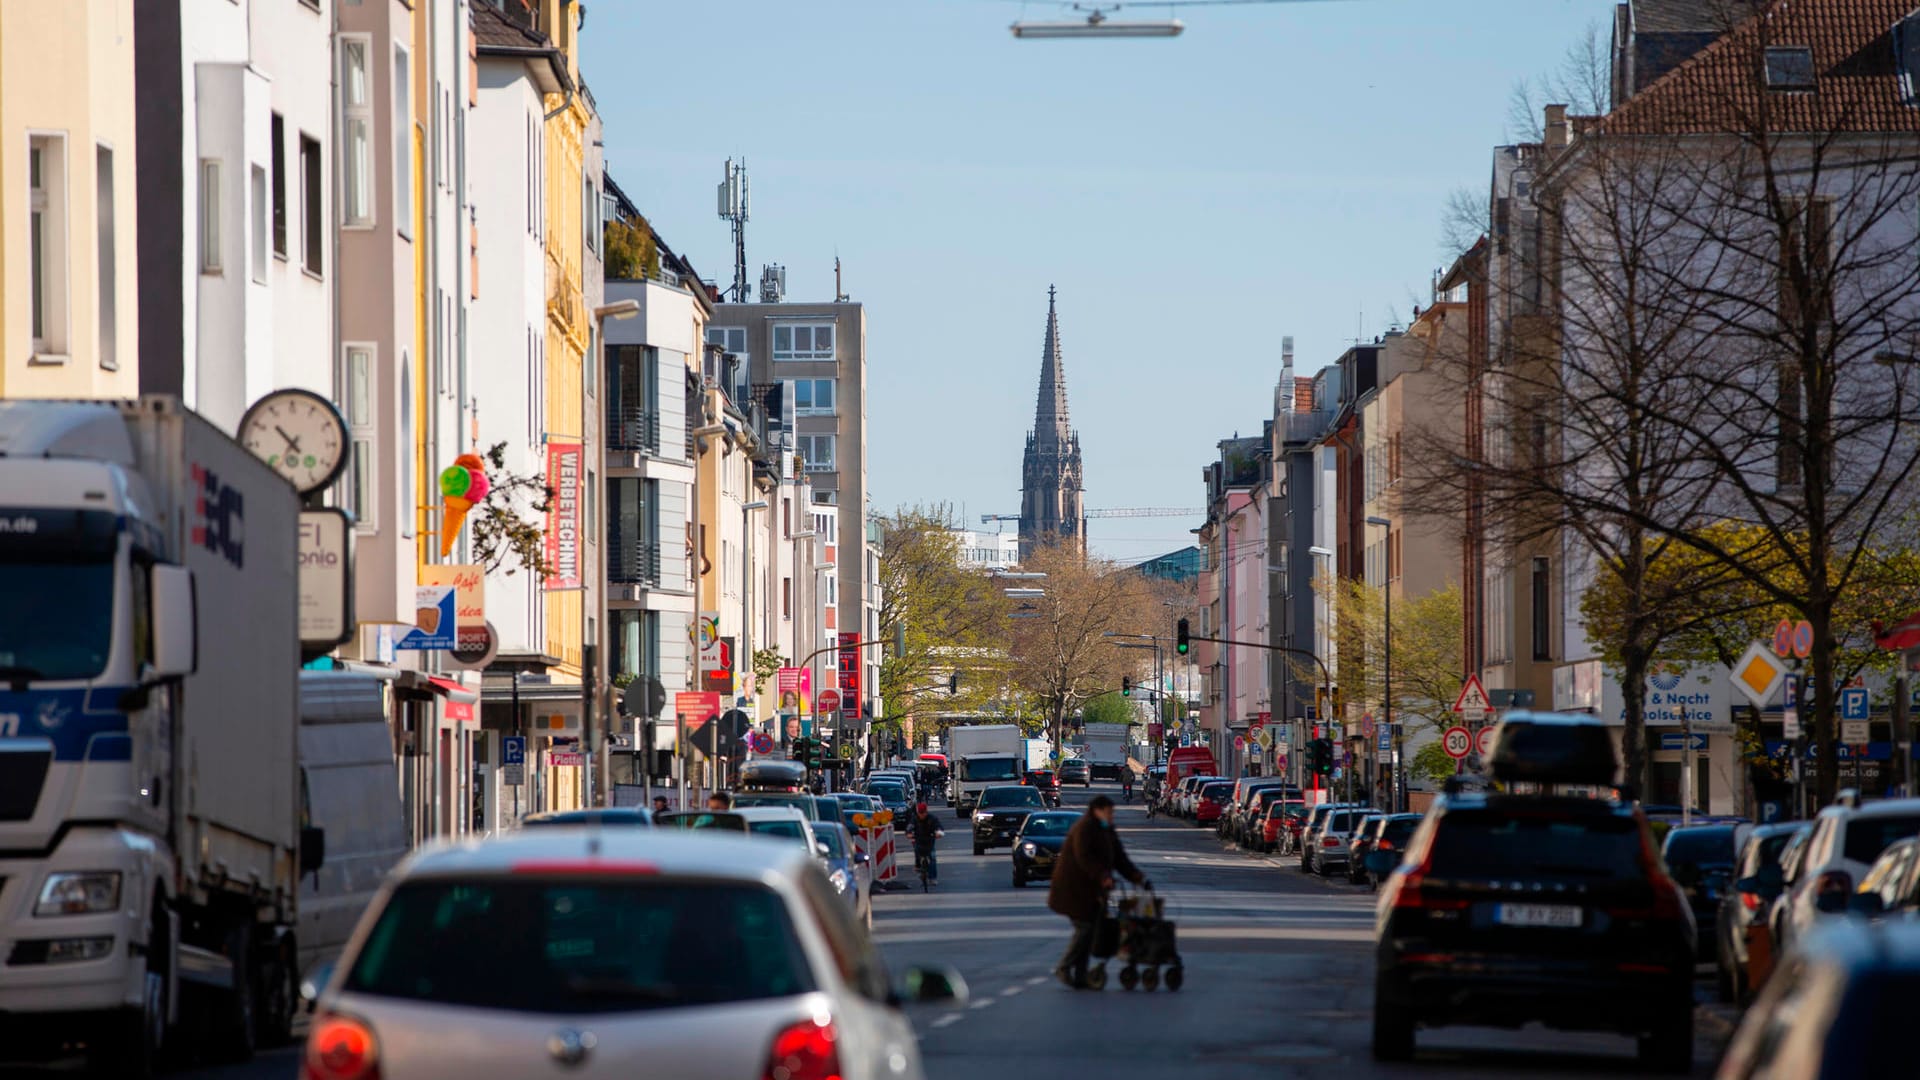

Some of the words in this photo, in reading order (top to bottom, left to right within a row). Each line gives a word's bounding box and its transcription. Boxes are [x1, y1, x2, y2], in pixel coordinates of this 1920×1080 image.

[559, 452, 578, 580] WERBETECHNIK
[1652, 693, 1662, 704] &
[1667, 693, 1710, 704] Nacht
[1848, 693, 1864, 715] P
[507, 740, 518, 760] P
[1449, 735, 1467, 750] 30
